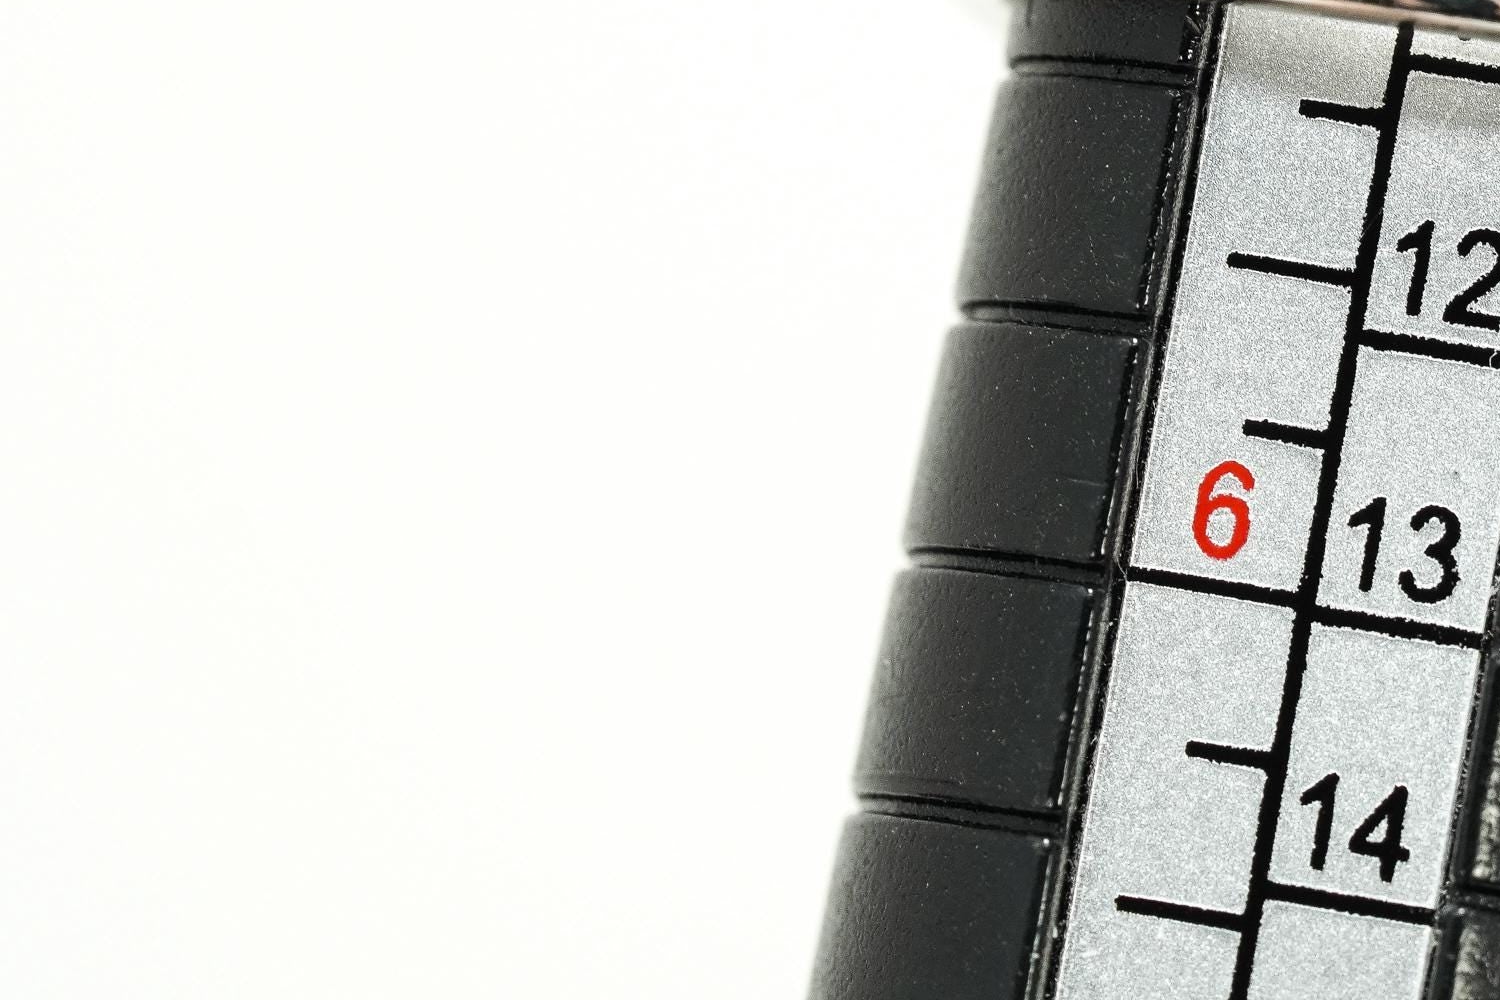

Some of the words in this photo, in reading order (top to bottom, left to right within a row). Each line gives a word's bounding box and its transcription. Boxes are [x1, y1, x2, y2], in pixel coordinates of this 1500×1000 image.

[1191, 460, 1255, 561] 6
[1346, 496, 1462, 605] 13
[1299, 772, 1411, 884] 14
